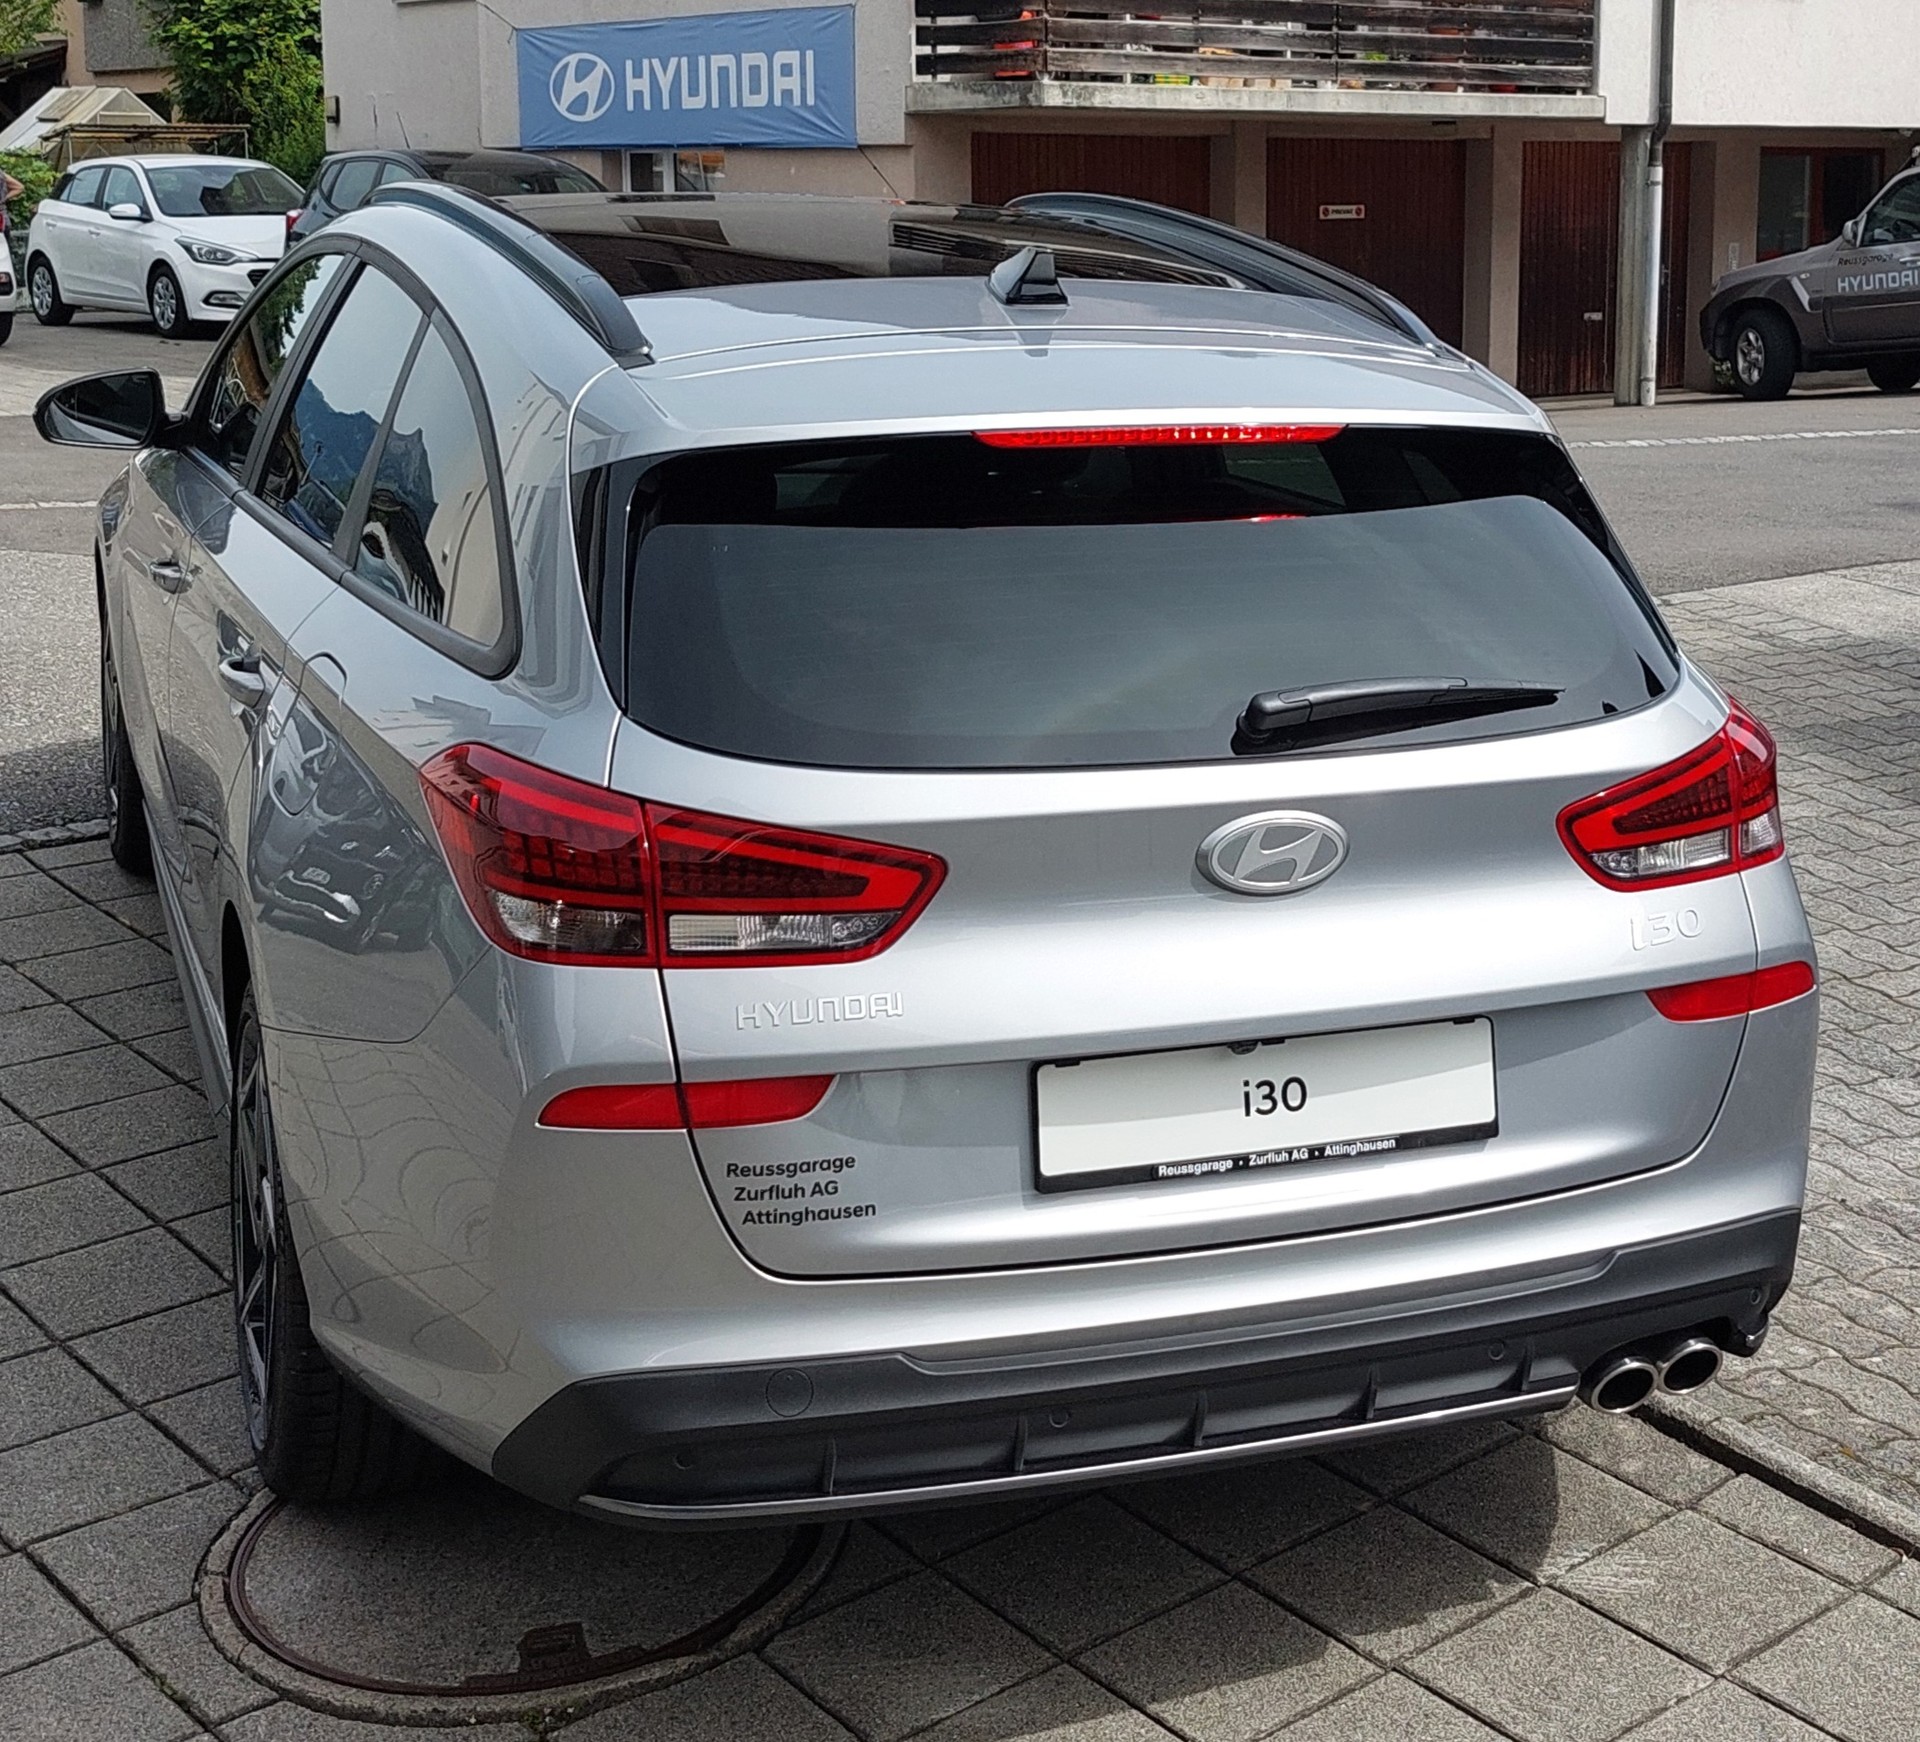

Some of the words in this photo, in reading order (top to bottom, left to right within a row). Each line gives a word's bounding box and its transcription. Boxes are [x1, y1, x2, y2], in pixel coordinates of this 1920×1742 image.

[625, 49, 815, 112] HYUNDAI
[1837, 269, 1919, 293] HYUNDAI
[736, 992, 903, 1030] HYUNDAI
[1242, 1076, 1308, 1117] i30
[726, 1155, 856, 1179] Reussgarage
[1158, 1158, 1234, 1178] Reussgarage
[1248, 1150, 1289, 1167] Zurfluh
[1291, 1147, 1309, 1160] AG
[1324, 1137, 1397, 1157] Attinghausen
[733, 1184, 805, 1202] Zurfluh
[810, 1180, 839, 1197] AG
[741, 1202, 877, 1226] Attinghausen
